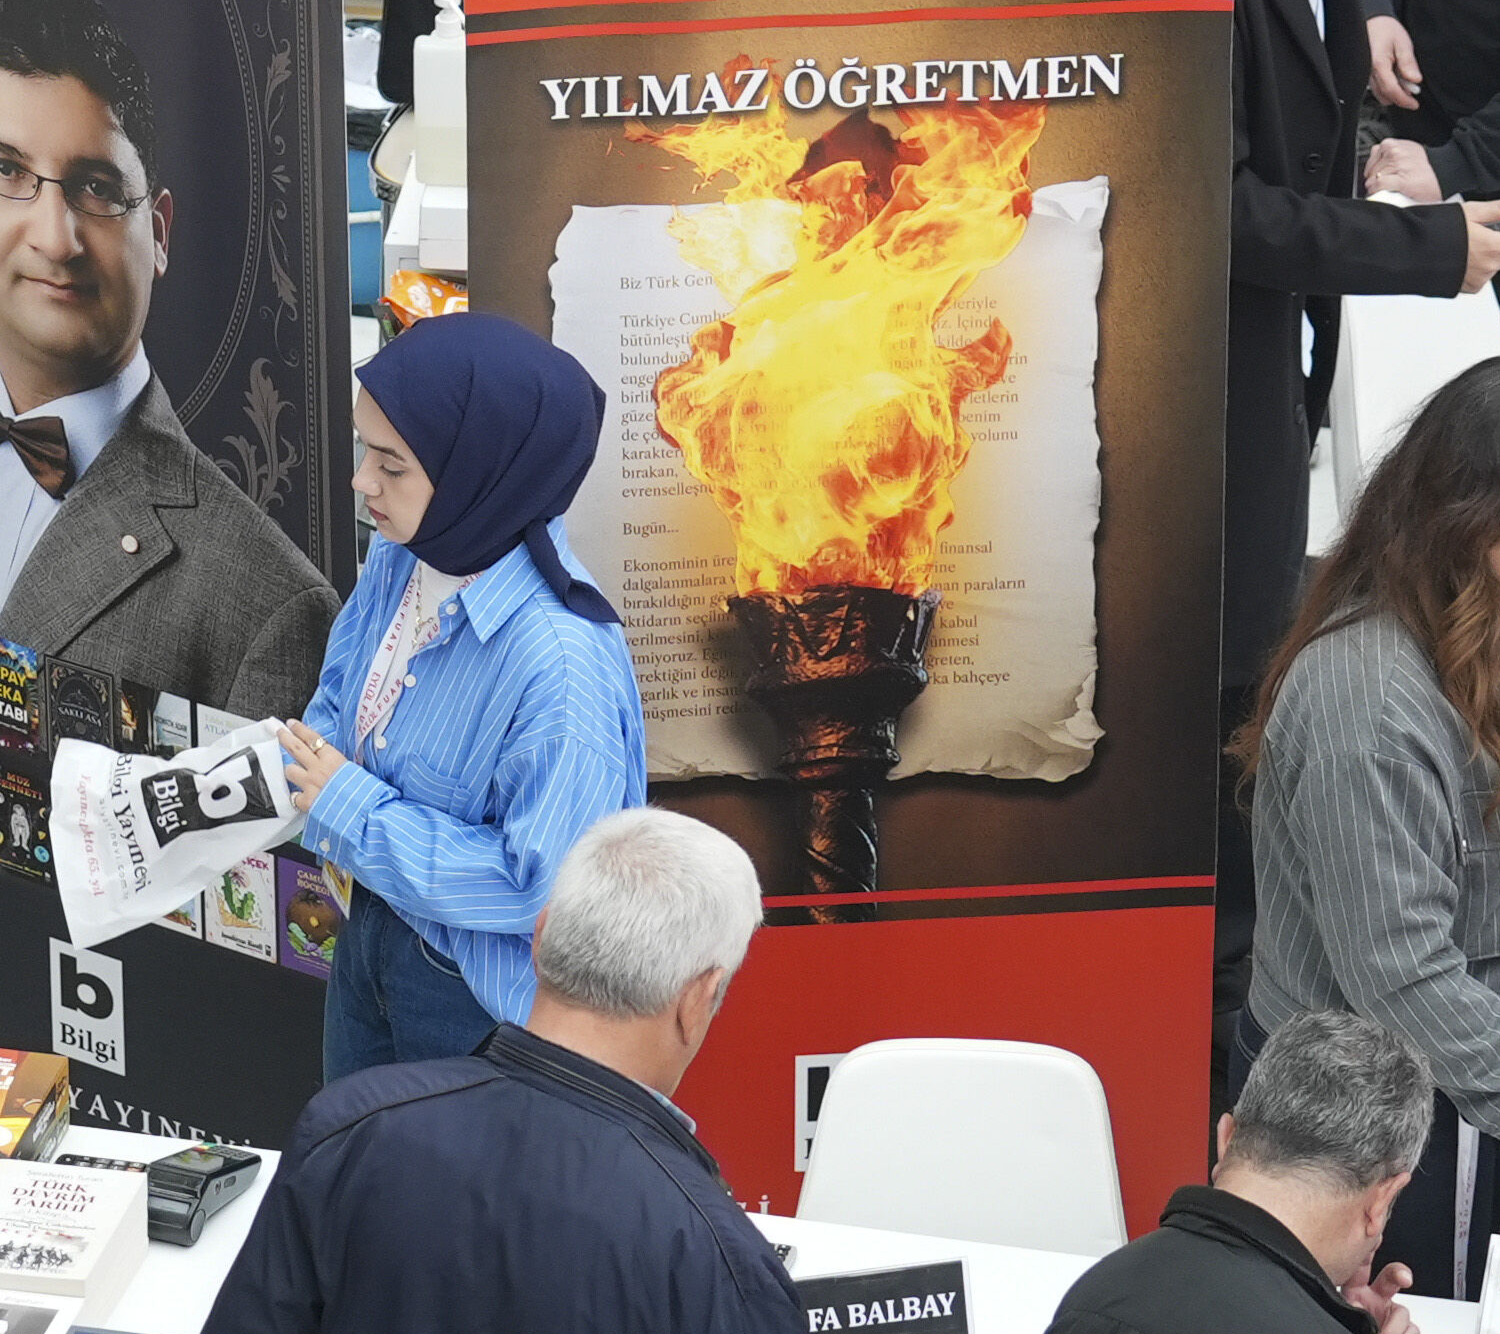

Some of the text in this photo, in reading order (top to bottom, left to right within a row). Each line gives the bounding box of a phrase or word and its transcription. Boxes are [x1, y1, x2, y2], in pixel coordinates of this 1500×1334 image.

[540, 52, 1124, 121] YILMAZ ÖĞRETMEN
[620, 276, 679, 290] Biz Türk
[620, 315, 675, 331] Türkiye
[622, 429, 639, 441] de
[971, 429, 1018, 443] yolunu
[622, 467, 678, 479] bırakan,
[623, 522, 679, 536] Bugün...
[939, 541, 992, 554] finansal
[624, 557, 707, 573] Ekonominin
[623, 575, 726, 592] dalgalanmalara
[964, 578, 1025, 594] paraların
[624, 596, 705, 610] bırakıldığını
[939, 616, 977, 628] kabul
[929, 635, 979, 648] ünmesi
[631, 650, 697, 666] tmiyoruz.
[953, 671, 1010, 686] bahçeye
[641, 686, 679, 703] garlık
[643, 704, 711, 722] nüşmesini
[152, 775, 188, 835] Bilgi
[113, 799, 152, 893] Yayınevi
[60, 1022, 118, 1063] Bilgi
[30, 1178, 87, 1193] TÜRK
[11, 1187, 96, 1204] DEVRİM
[13, 1197, 87, 1213] TARİHİ
[847, 1291, 957, 1328] BALBAY
